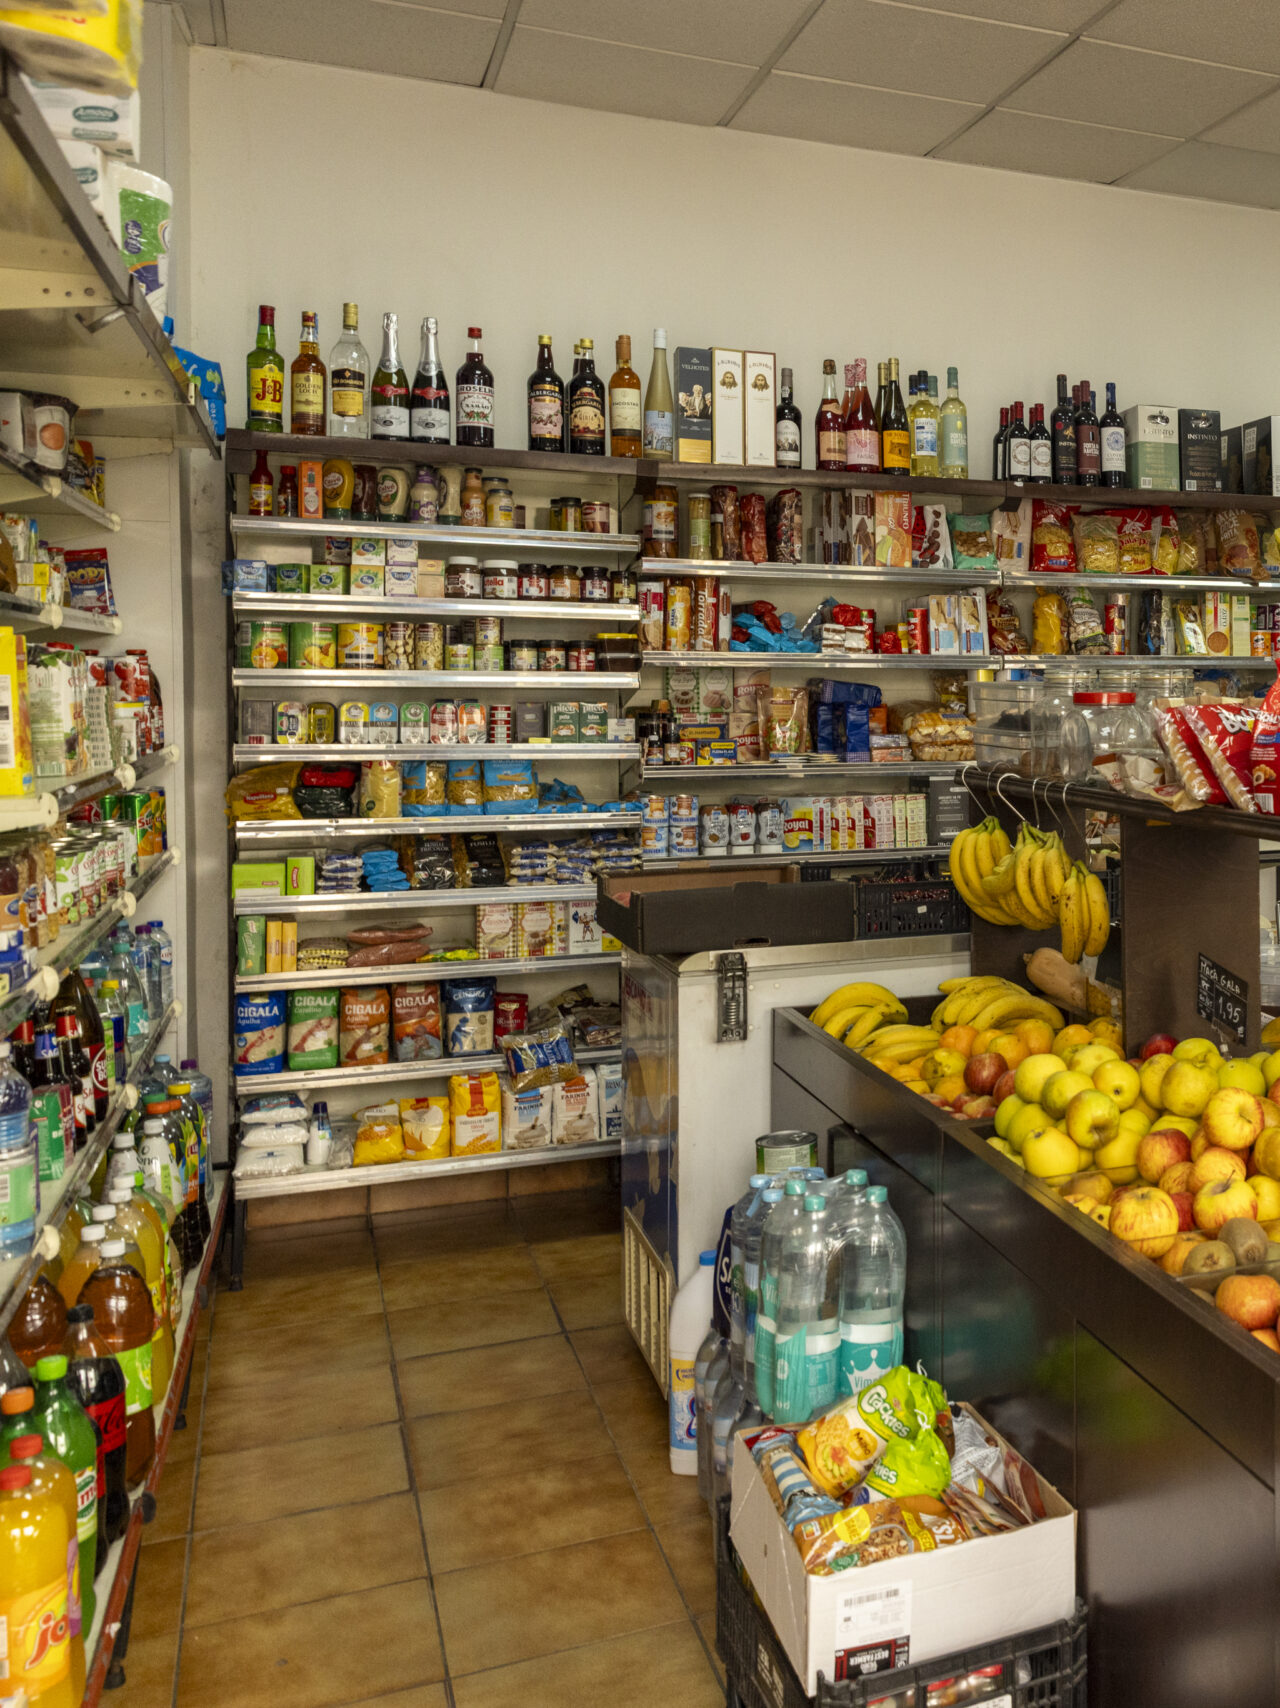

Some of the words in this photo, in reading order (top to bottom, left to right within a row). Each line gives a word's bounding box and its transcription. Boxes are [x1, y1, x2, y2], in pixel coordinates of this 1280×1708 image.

[256, 378, 282, 403] J&B
[484, 578, 504, 586] utella
[784, 820, 809, 831] Royal
[1220, 974, 1241, 995] GALA
[295, 994, 337, 1007] CIGALA
[395, 995, 435, 1007] CIGALA
[237, 1006, 279, 1018] CIGALA
[345, 1004, 385, 1015] CIGALA
[1218, 996, 1241, 1024] 1,95
[237, 1017, 261, 1025] Agulha
[862, 1386, 910, 1439] Crackies
